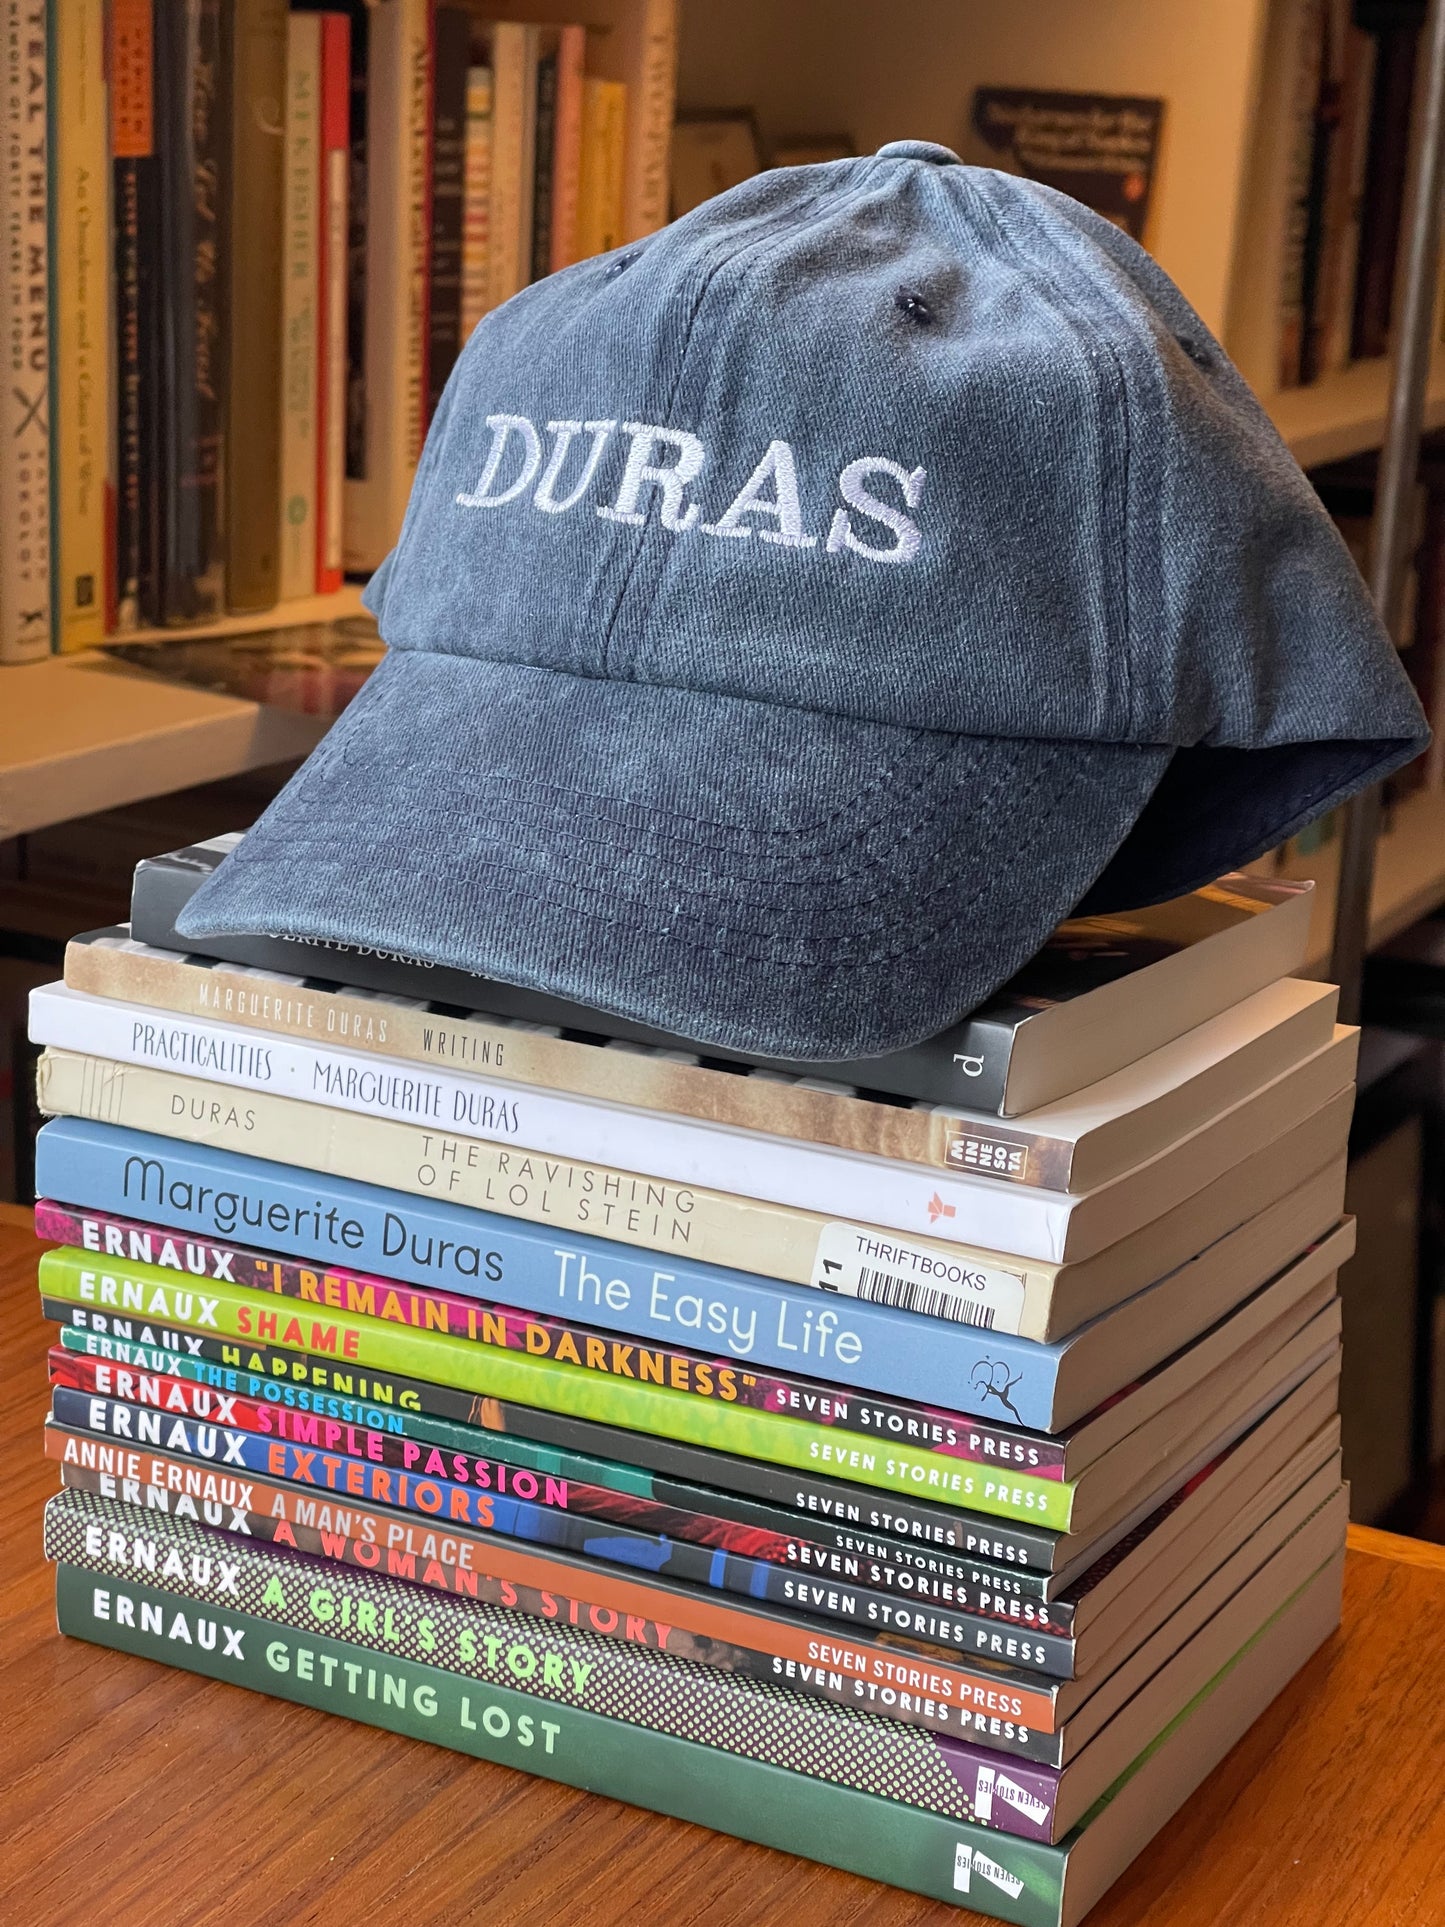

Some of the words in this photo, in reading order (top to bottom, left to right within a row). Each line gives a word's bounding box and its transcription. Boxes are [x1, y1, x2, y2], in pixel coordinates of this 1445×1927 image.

[28, 138, 46, 224] THE
[29, 245, 48, 371] MENU
[456, 413, 927, 563] DURAS
[132, 1021, 273, 1081] PRACTICALITIES
[312, 1059, 443, 1119] MARGUERITE
[454, 1089, 520, 1134] DURAS
[199, 983, 313, 1029] MARGUERITE
[327, 1008, 388, 1043] DURAS
[422, 1027, 505, 1067] WRITING
[171, 1094, 257, 1132] DURAS
[421, 1135, 480, 1168] THE
[498, 1151, 697, 1214] RAVISHING
[81, 1219, 236, 1283] ERNAUX
[123, 1155, 366, 1249] Marguerite
[382, 1213, 504, 1282] Duras
[416, 1164, 462, 1191] OF
[485, 1178, 551, 1214] LOL
[577, 1198, 693, 1244] STEIN
[856, 1235, 987, 1291] THRIFTBOOKS
[255, 1259, 283, 1295] "I
[300, 1270, 450, 1334] REMAIN
[467, 1309, 508, 1347] IN
[525, 1322, 757, 1402] DARKNESS"
[553, 1249, 632, 1312] The
[649, 1271, 757, 1354] Easy
[776, 1300, 863, 1365] Life
[72, 1308, 204, 1357] ERNAUX
[221, 1344, 422, 1412] HAPPENING
[795, 1491, 860, 1523] SEVEN
[869, 1511, 957, 1547] STORIES
[966, 1534, 1029, 1566] PRESS
[79, 1271, 220, 1328] ERNAUX
[236, 1306, 361, 1360] SHAME
[809, 1441, 876, 1472] SEVEN
[885, 1459, 974, 1495] STORIES
[983, 1481, 1048, 1512] PRESS
[776, 1388, 849, 1421] SEVEN
[860, 1408, 957, 1447] STORIES
[969, 1433, 1040, 1466] PRESS
[86, 1333, 183, 1378] ERNAUX
[193, 1361, 238, 1393] THE
[248, 1374, 406, 1436] POSSESSION
[836, 1534, 888, 1560] SEVEN
[895, 1551, 965, 1580] STORIES
[971, 1570, 1022, 1596] PRESS
[95, 1363, 238, 1425] ERNAUX
[257, 1404, 385, 1462] SIMPLE
[403, 1440, 569, 1509] PASSION
[786, 1543, 860, 1578] SEVEN
[870, 1563, 968, 1605] STORIES
[979, 1591, 1050, 1625] PRESS
[63, 1437, 142, 1481] ANNIE
[151, 1460, 254, 1511] ERNAUX
[271, 1493, 287, 1520] A
[296, 1499, 377, 1544] MAN'S
[387, 1523, 475, 1572] PLACE
[807, 1641, 867, 1673] SEVEN
[872, 1659, 953, 1697] STORIES
[959, 1682, 1023, 1717] PRESS
[88, 1399, 248, 1467] ERNAUX
[267, 1443, 496, 1528] EXTERIORS
[784, 1580, 856, 1615] SEVEN
[867, 1602, 965, 1643] STORIES
[975, 1629, 1047, 1665] PRESS
[85, 1525, 241, 1597] ERNAUX
[262, 1575, 288, 1610] A
[308, 1590, 437, 1655] GIRL'S
[458, 1628, 595, 1696] STORY
[93, 1587, 246, 1662] ERNAUX
[265, 1640, 440, 1718] GETTING
[460, 1695, 562, 1755] LOST
[99, 1472, 253, 1536] ERNAUX
[272, 1520, 298, 1548] A
[319, 1531, 519, 1607] WOMAN'S
[540, 1590, 674, 1650] STORY
[772, 1656, 843, 1692] SEVEN
[853, 1679, 949, 1721] STORIES
[960, 1708, 1030, 1744] PRESS
